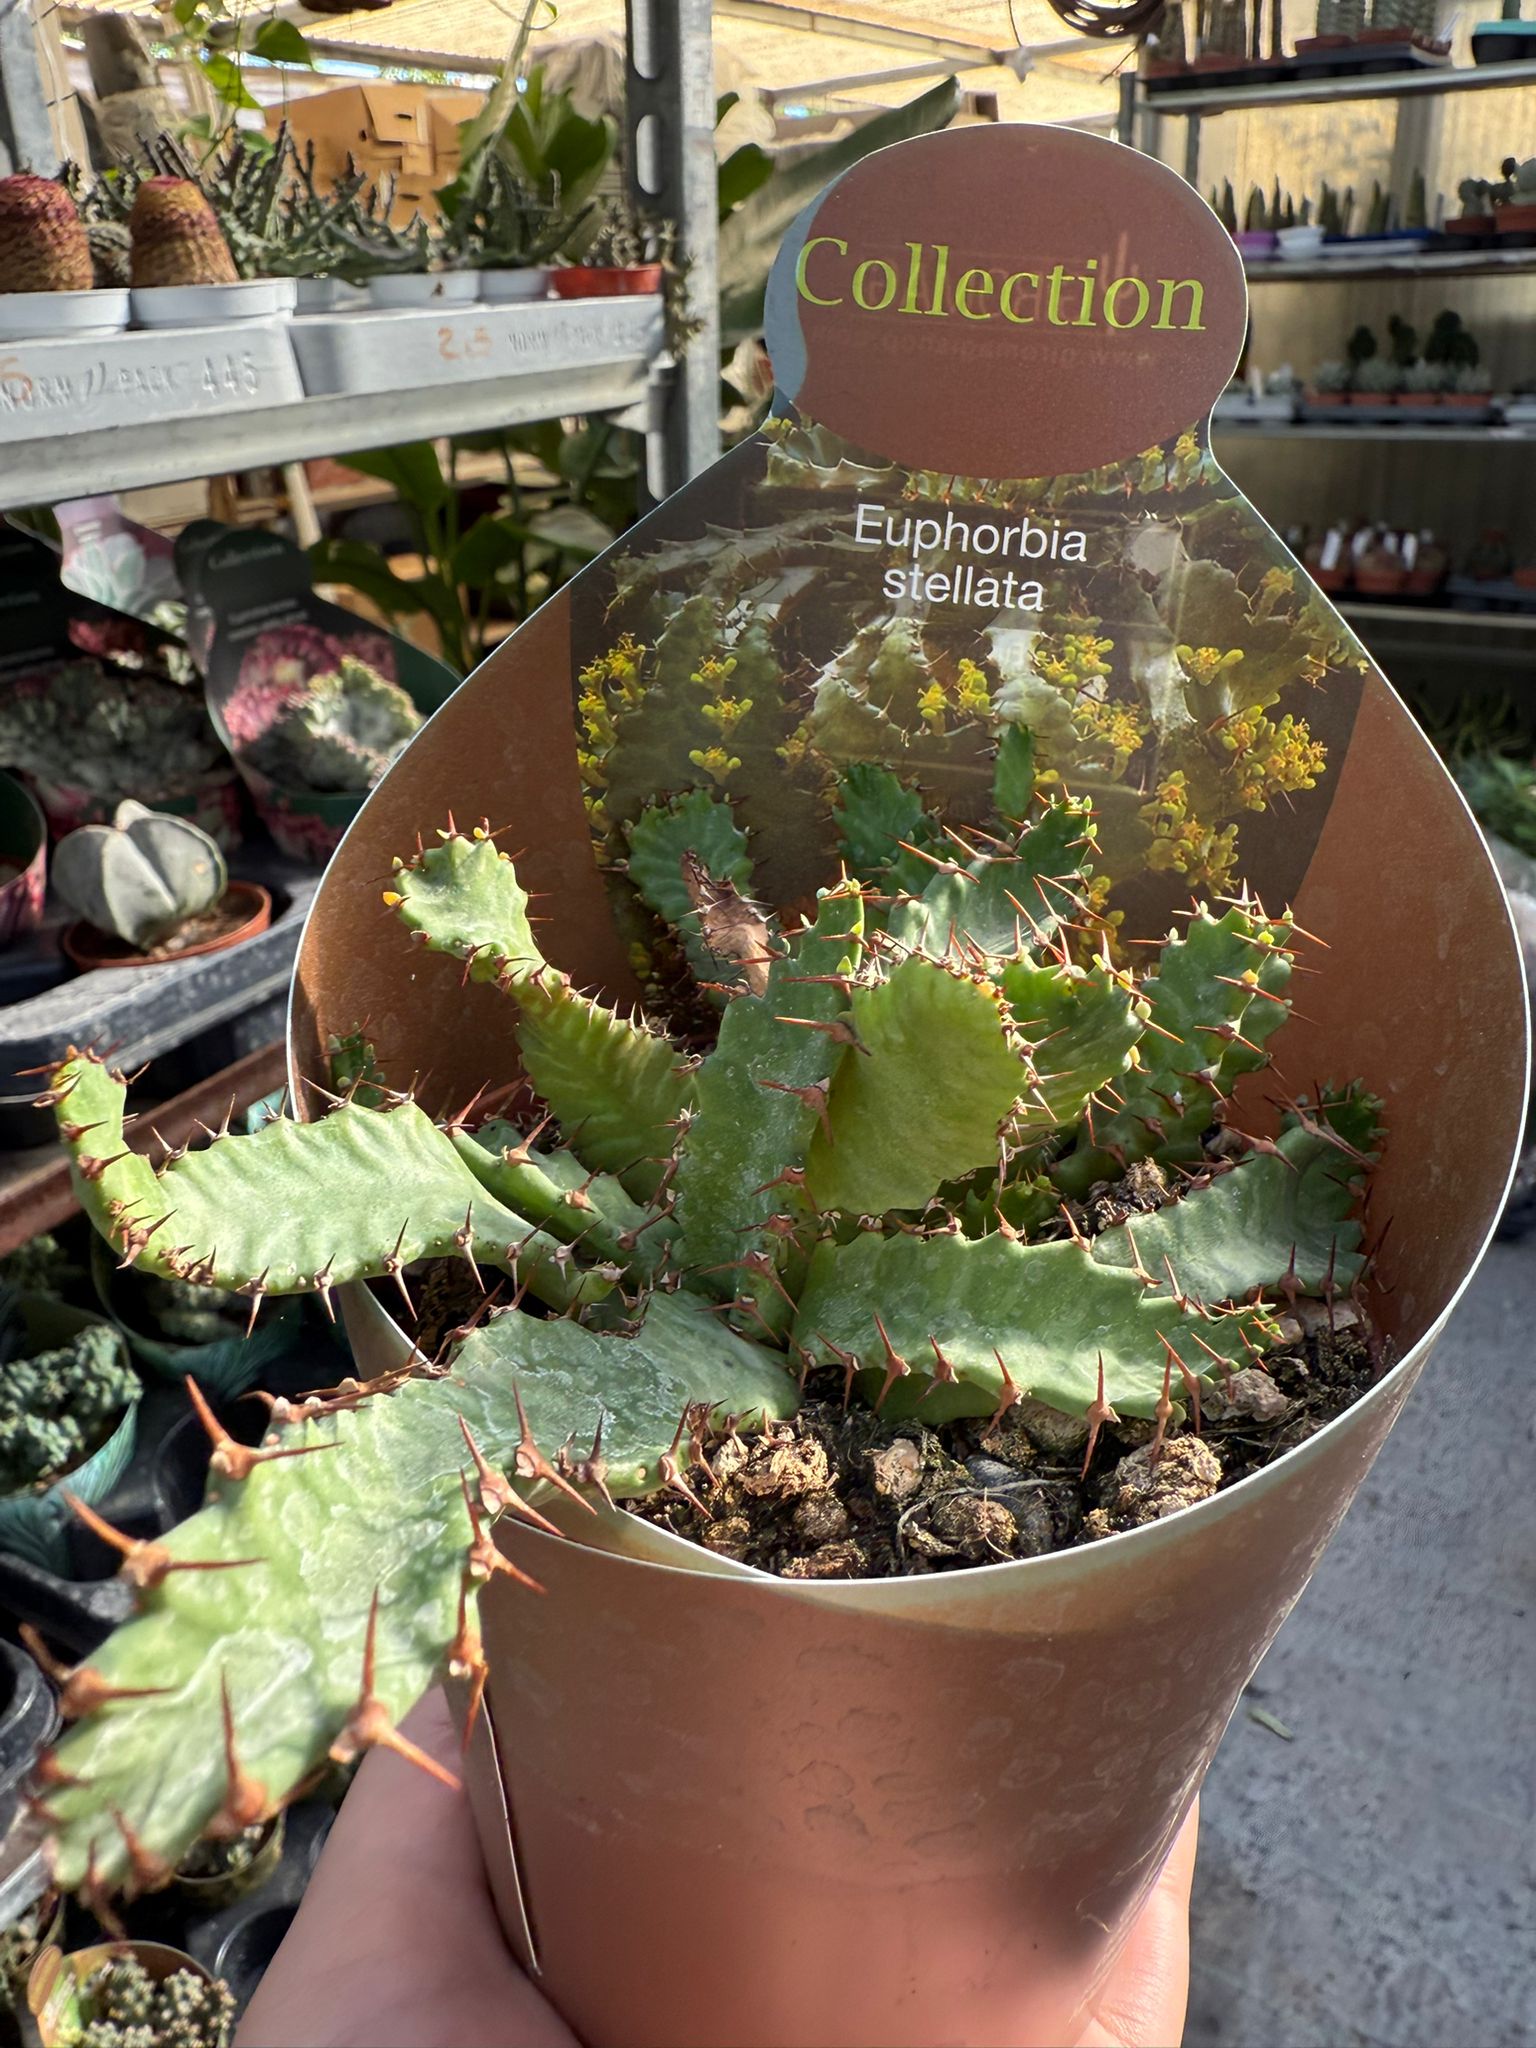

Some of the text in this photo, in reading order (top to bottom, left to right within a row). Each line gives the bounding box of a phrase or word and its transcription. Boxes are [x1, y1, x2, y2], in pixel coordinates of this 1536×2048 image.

[795, 237, 1206, 331] Collection
[854, 503, 1088, 563] Euphorbia
[882, 563, 1044, 612] stellata
